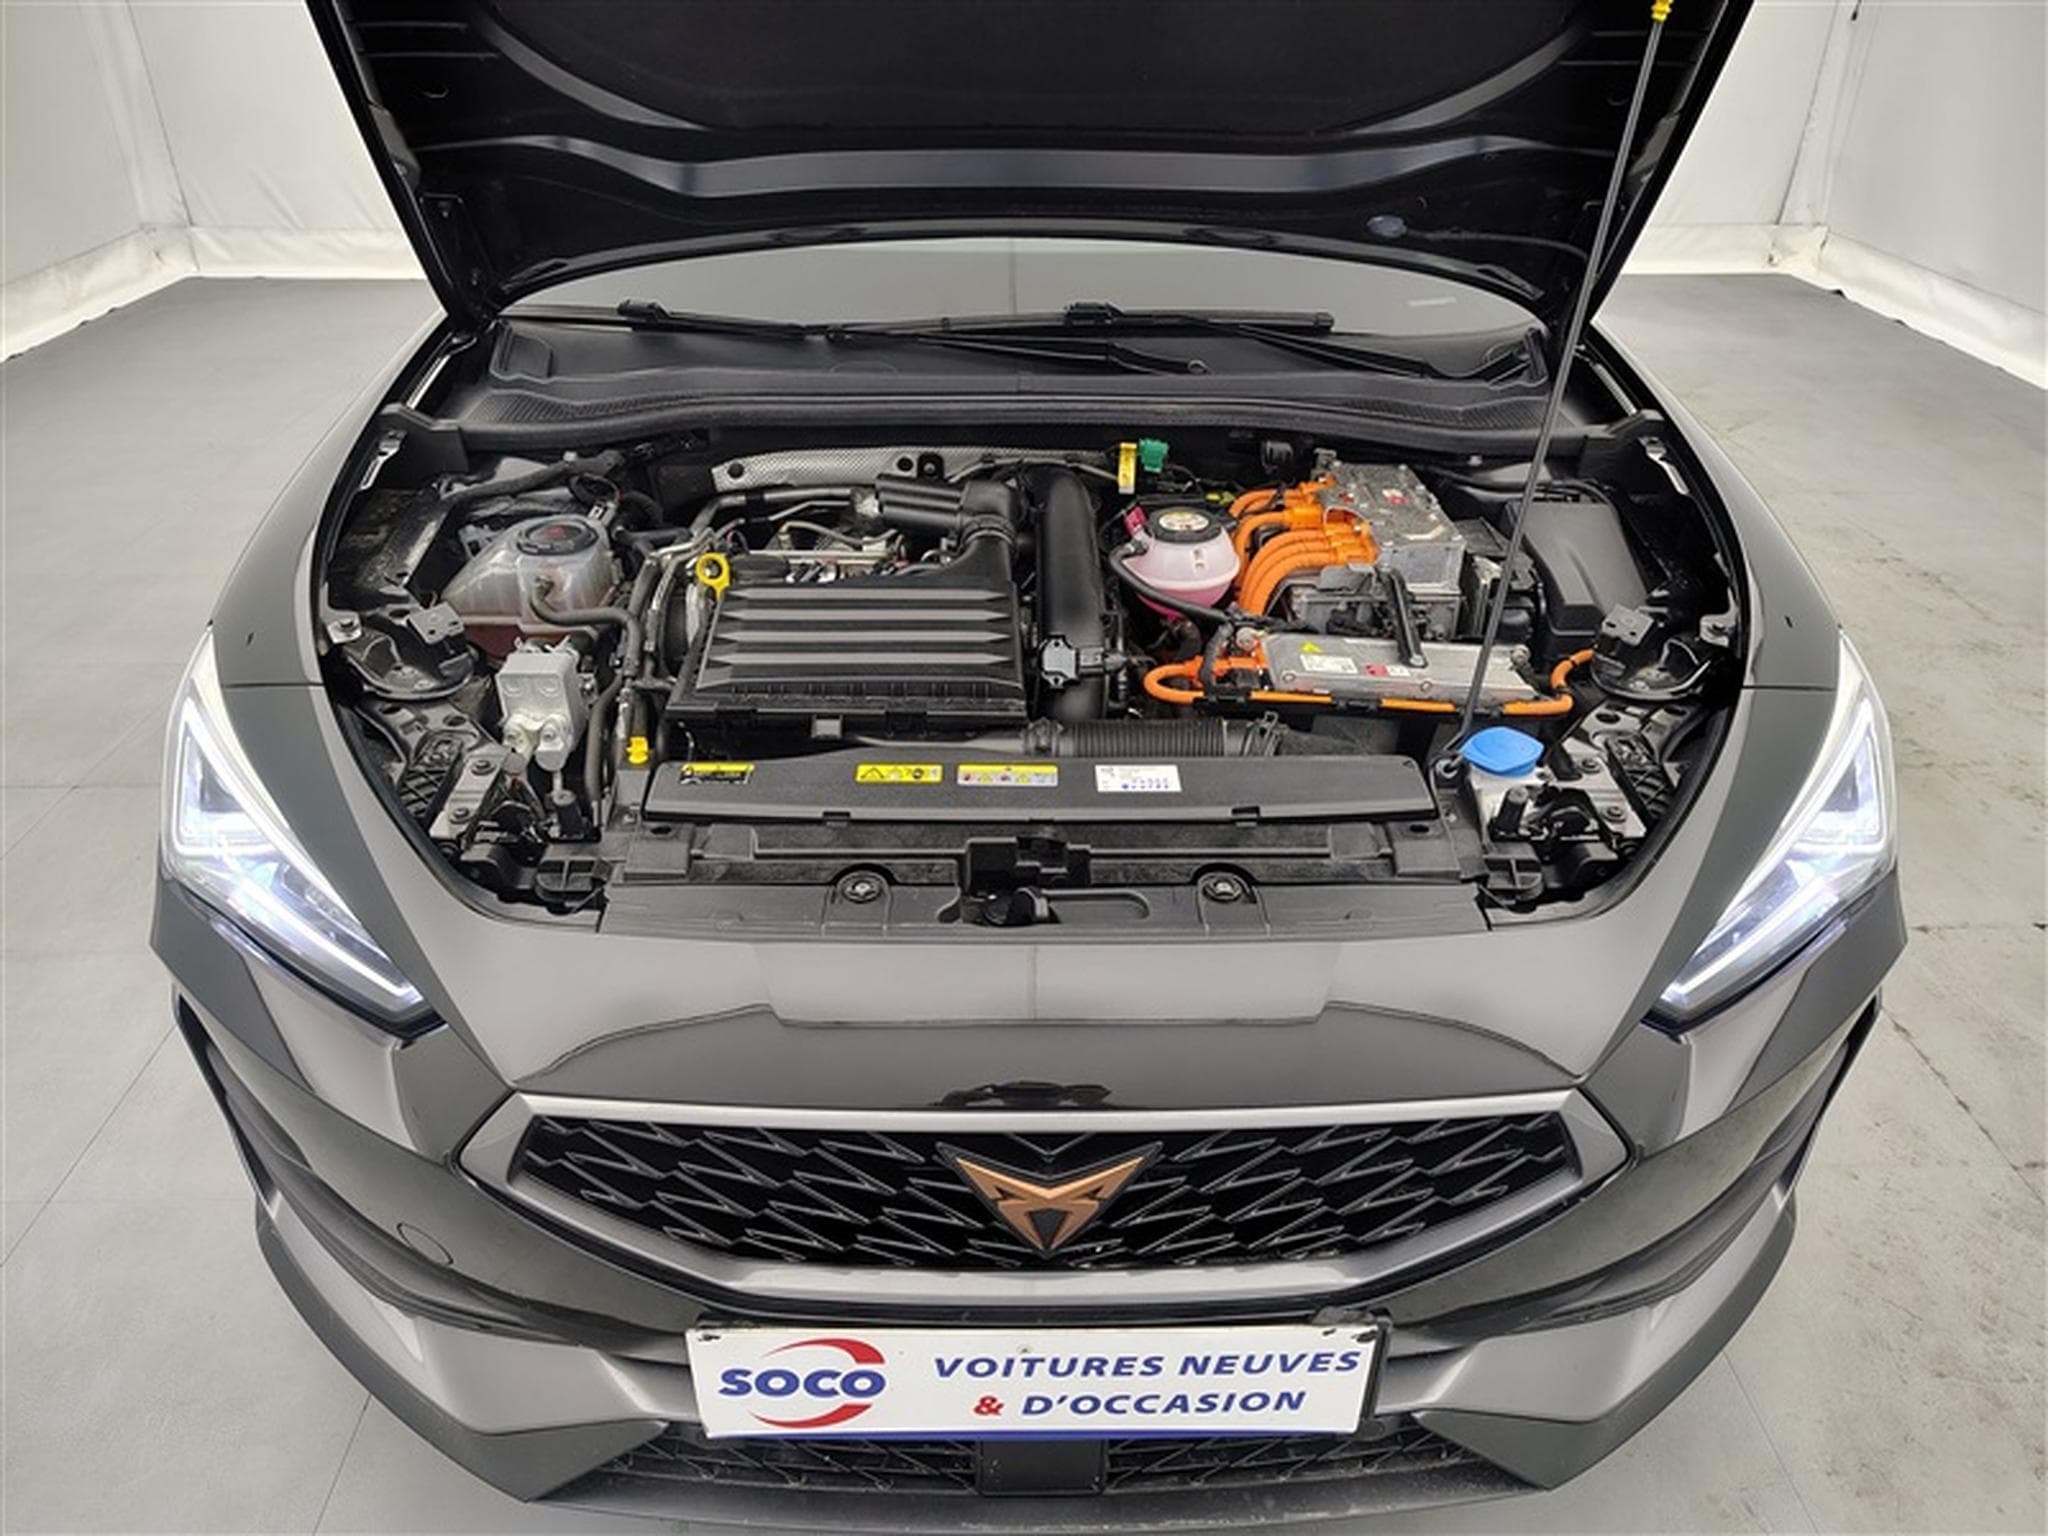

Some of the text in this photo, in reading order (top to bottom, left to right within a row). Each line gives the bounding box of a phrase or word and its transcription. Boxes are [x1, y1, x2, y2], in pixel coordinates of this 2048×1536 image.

[933, 1350, 1360, 1379] VOITURES NEUVES
[718, 1367, 887, 1400] SOCO
[972, 1390, 1306, 1417] & D'OCCASION
